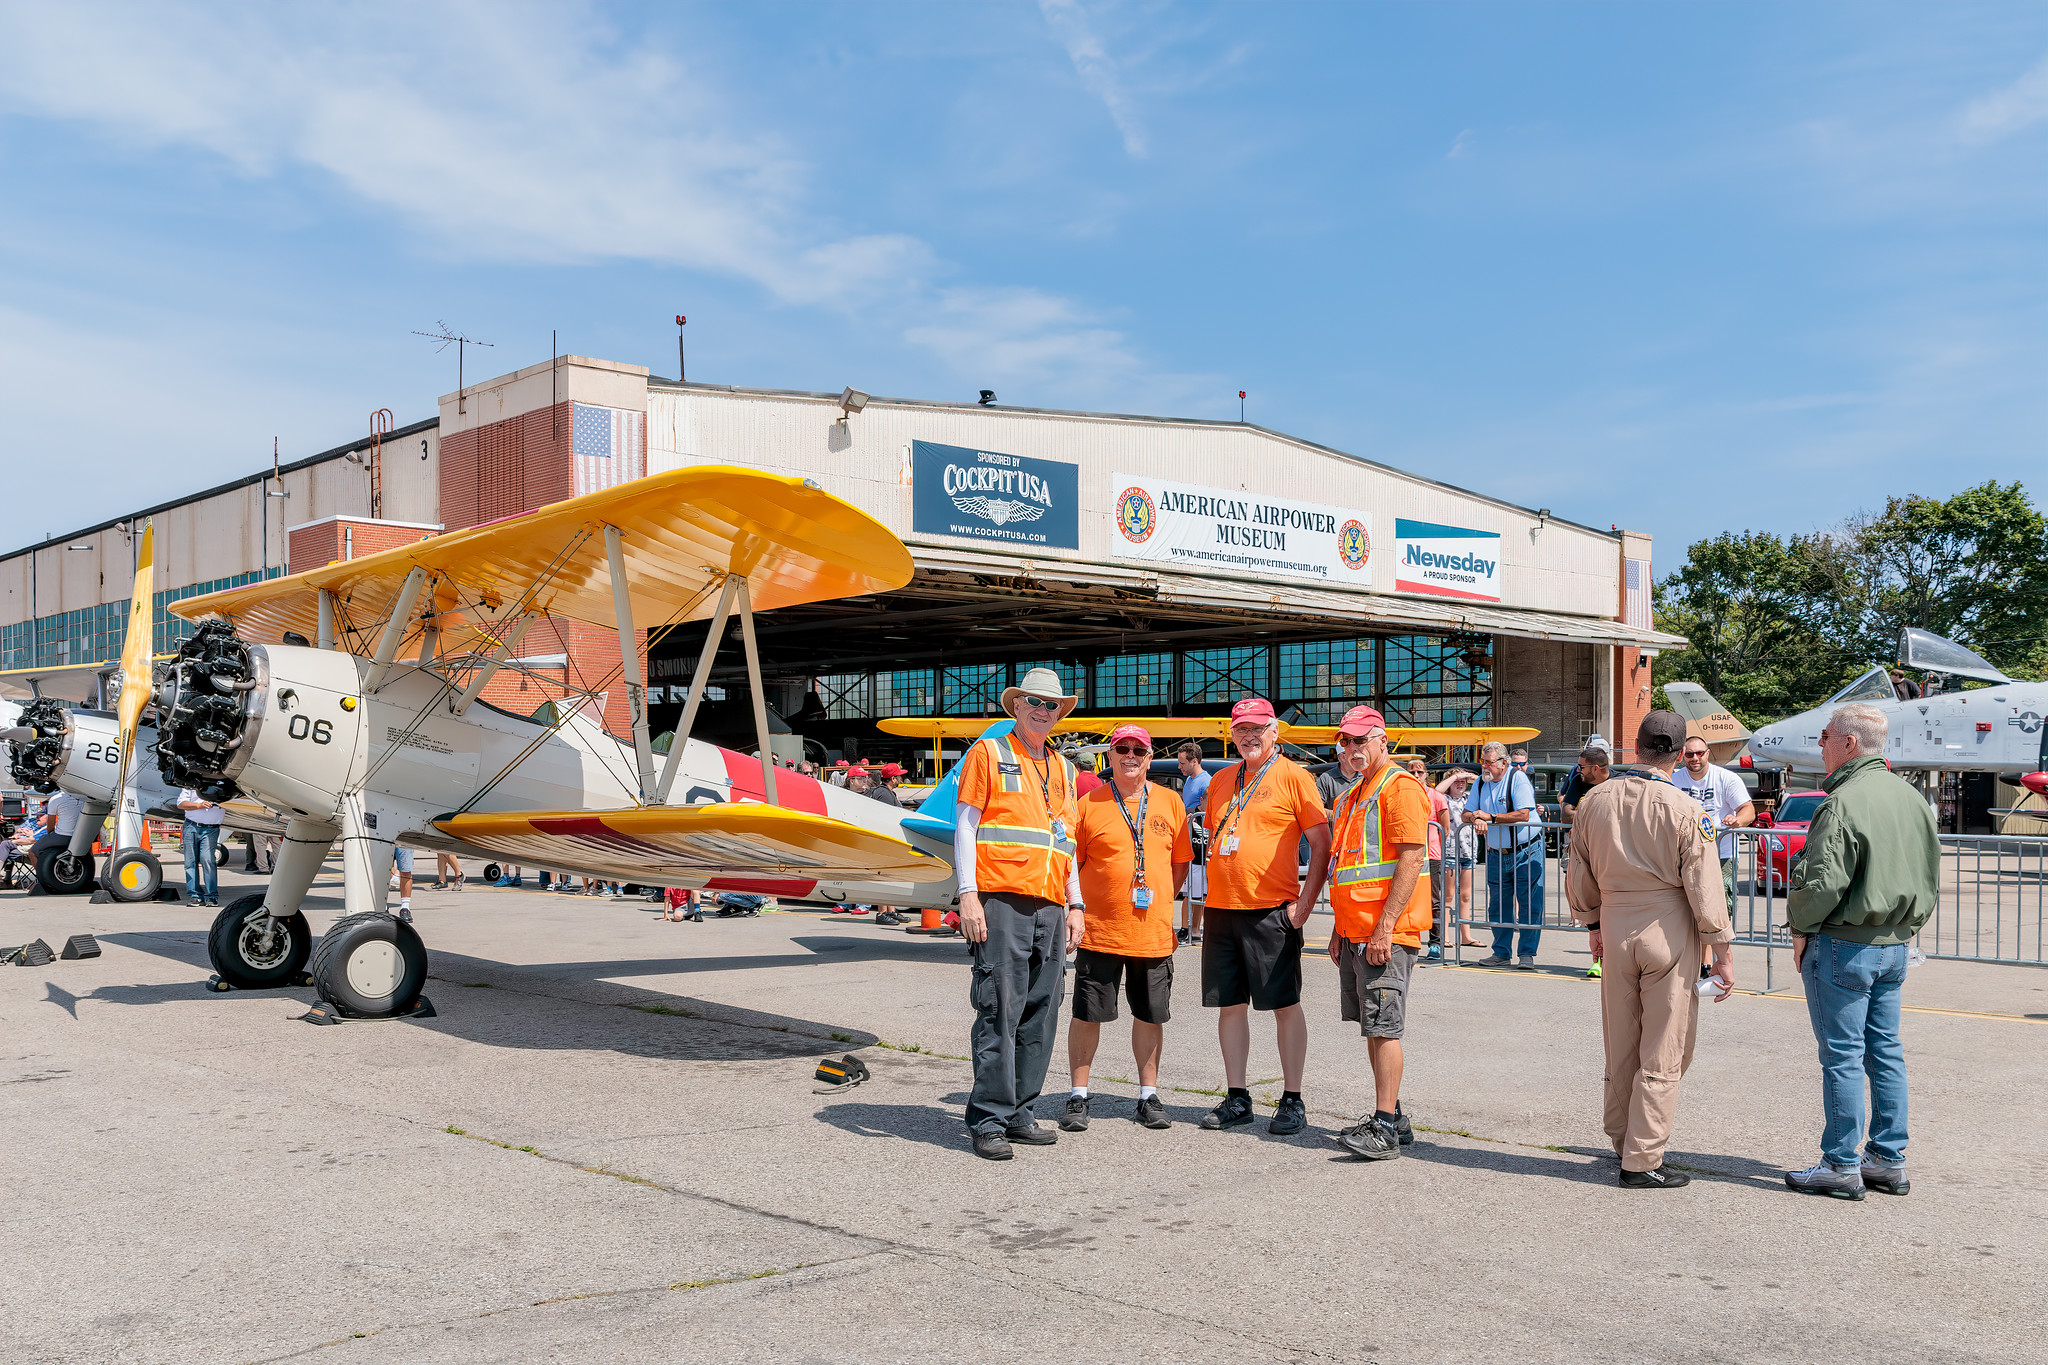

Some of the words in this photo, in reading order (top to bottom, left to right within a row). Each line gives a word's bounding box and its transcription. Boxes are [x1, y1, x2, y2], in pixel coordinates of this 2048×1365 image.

[421, 439, 428, 461] 3
[977, 452, 1011, 466] SPONSORED
[1012, 457, 1020, 467] BY
[1159, 490, 1249, 521] AMERICAN
[1252, 504, 1337, 534] AIRPOWER
[950, 524, 1047, 543] WWW.COCKPITUSA.COM
[1216, 523, 1287, 551] MUSEUM
[1170, 546, 1328, 578] www.americanairpowermuseum.org
[1406, 543, 1496, 579] Newsday
[1423, 570, 1428, 578] A
[1428, 571, 1448, 580] PROUD
[1449, 573, 1476, 584] SPONSOR
[657, 656, 700, 677] SMOKIN
[288, 713, 334, 746] 06
[1763, 736, 1784, 746] 247
[86, 742, 120, 764] 26
